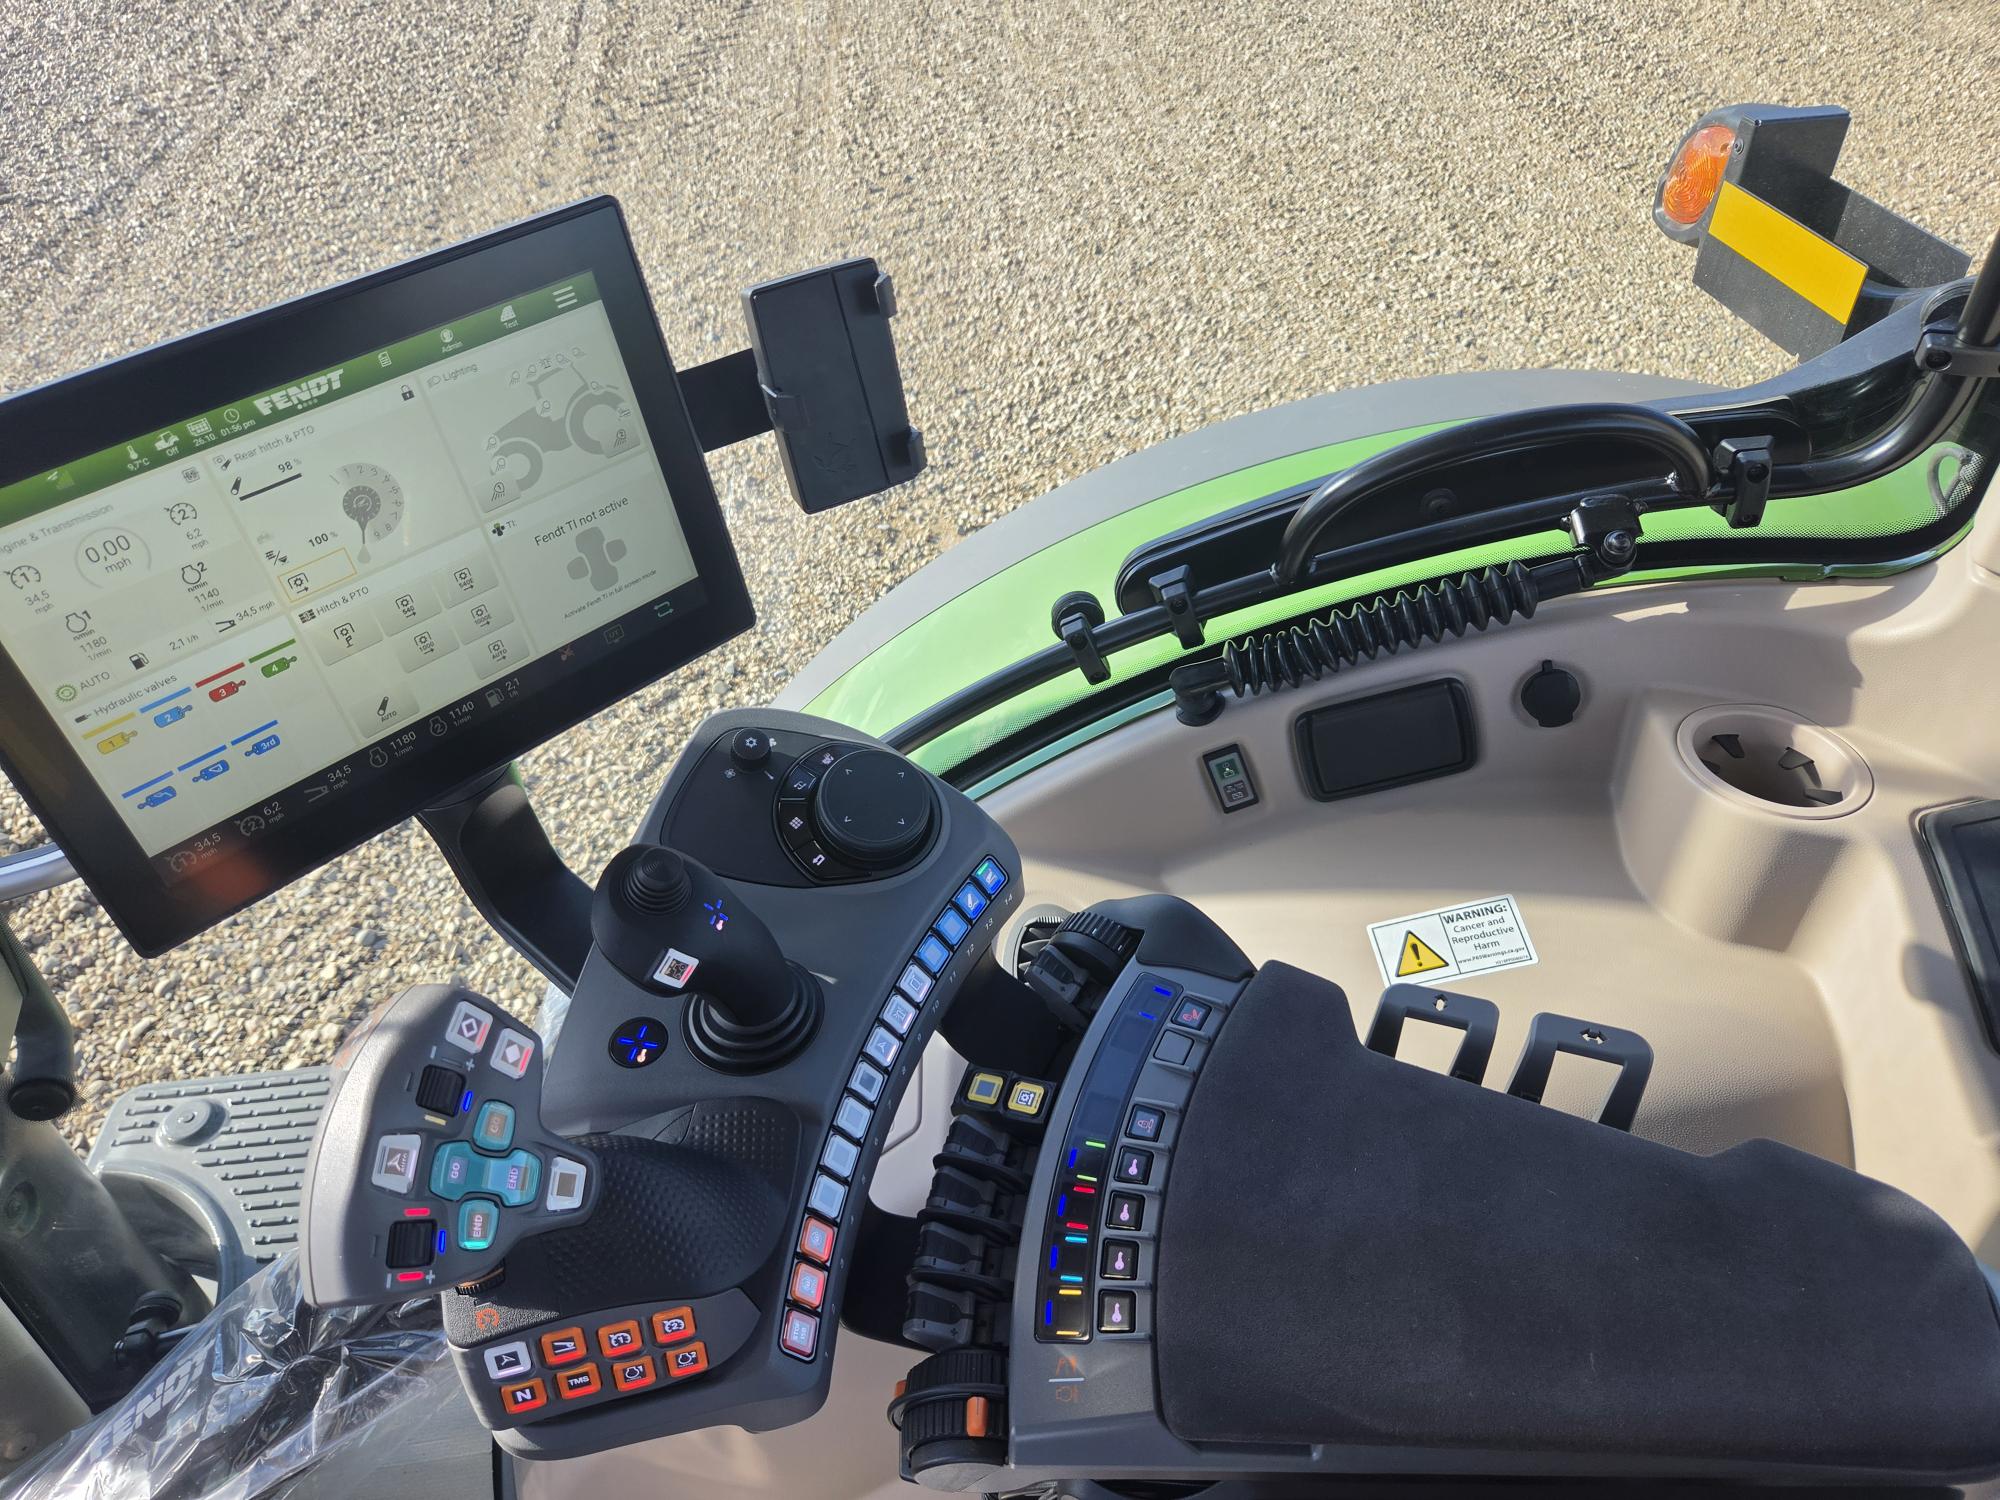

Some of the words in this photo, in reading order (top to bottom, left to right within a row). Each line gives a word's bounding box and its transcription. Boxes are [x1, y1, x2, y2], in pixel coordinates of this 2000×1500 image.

[442, 364, 478, 383] Lighting
[253, 368, 344, 416] FENDT
[220, 425, 242, 437] 01:56
[243, 419, 256, 430] pm
[165, 446, 179, 457] Off
[233, 448, 257, 463] Rear
[259, 436, 283, 453] hitch
[284, 433, 292, 443] &
[292, 425, 315, 440] PTO
[277, 461, 293, 473] 98
[29, 532, 39, 542] &
[40, 504, 115, 537] Transmission
[534, 520, 566, 547] Fendt
[566, 515, 579, 531] TI
[579, 510, 597, 527] not
[598, 496, 629, 518] active
[186, 528, 203, 540] 6,2
[308, 533, 329, 548] 100
[85, 535, 131, 563] 0,00
[191, 538, 209, 551] mph
[105, 556, 132, 574] mph
[197, 562, 207, 572] 2
[24, 590, 50, 606] 34,5
[193, 587, 220, 604] 1140
[316, 600, 341, 616] Hitch
[341, 595, 349, 604] &
[350, 587, 369, 602] PTO
[200, 599, 224, 612] 1/min
[235, 606, 258, 621] 34,5
[258, 600, 276, 613] mph
[79, 636, 108, 653] 1180
[169, 638, 186, 651] 2,1
[87, 648, 113, 661] 1/min
[491, 648, 508, 660] AUTO
[80, 671, 110, 691] AUTO
[505, 677, 520, 692] 2,1
[93, 688, 144, 717] Hydraulic
[144, 673, 178, 694] valves
[381, 710, 397, 723] AUTO
[449, 701, 475, 719] 1140
[260, 736, 277, 750] 3rd
[389, 731, 417, 750] 1180
[327, 764, 352, 782] 34,5
[263, 801, 282, 816] 6,2
[268, 813, 285, 824] mph
[195, 832, 222, 851] 34,5
[1443, 904, 1508, 924] WARNING:
[1453, 921, 1485, 933] Cancer
[1487, 916, 1506, 926] and
[1451, 926, 1515, 944] Reproductive
[1473, 940, 1500, 951] Harm
[451, 1162, 461, 1179] GO
[508, 1167, 519, 1190] END
[473, 1214, 483, 1238] END
[568, 1375, 590, 1386] TMS
[515, 1388, 532, 1402] N
